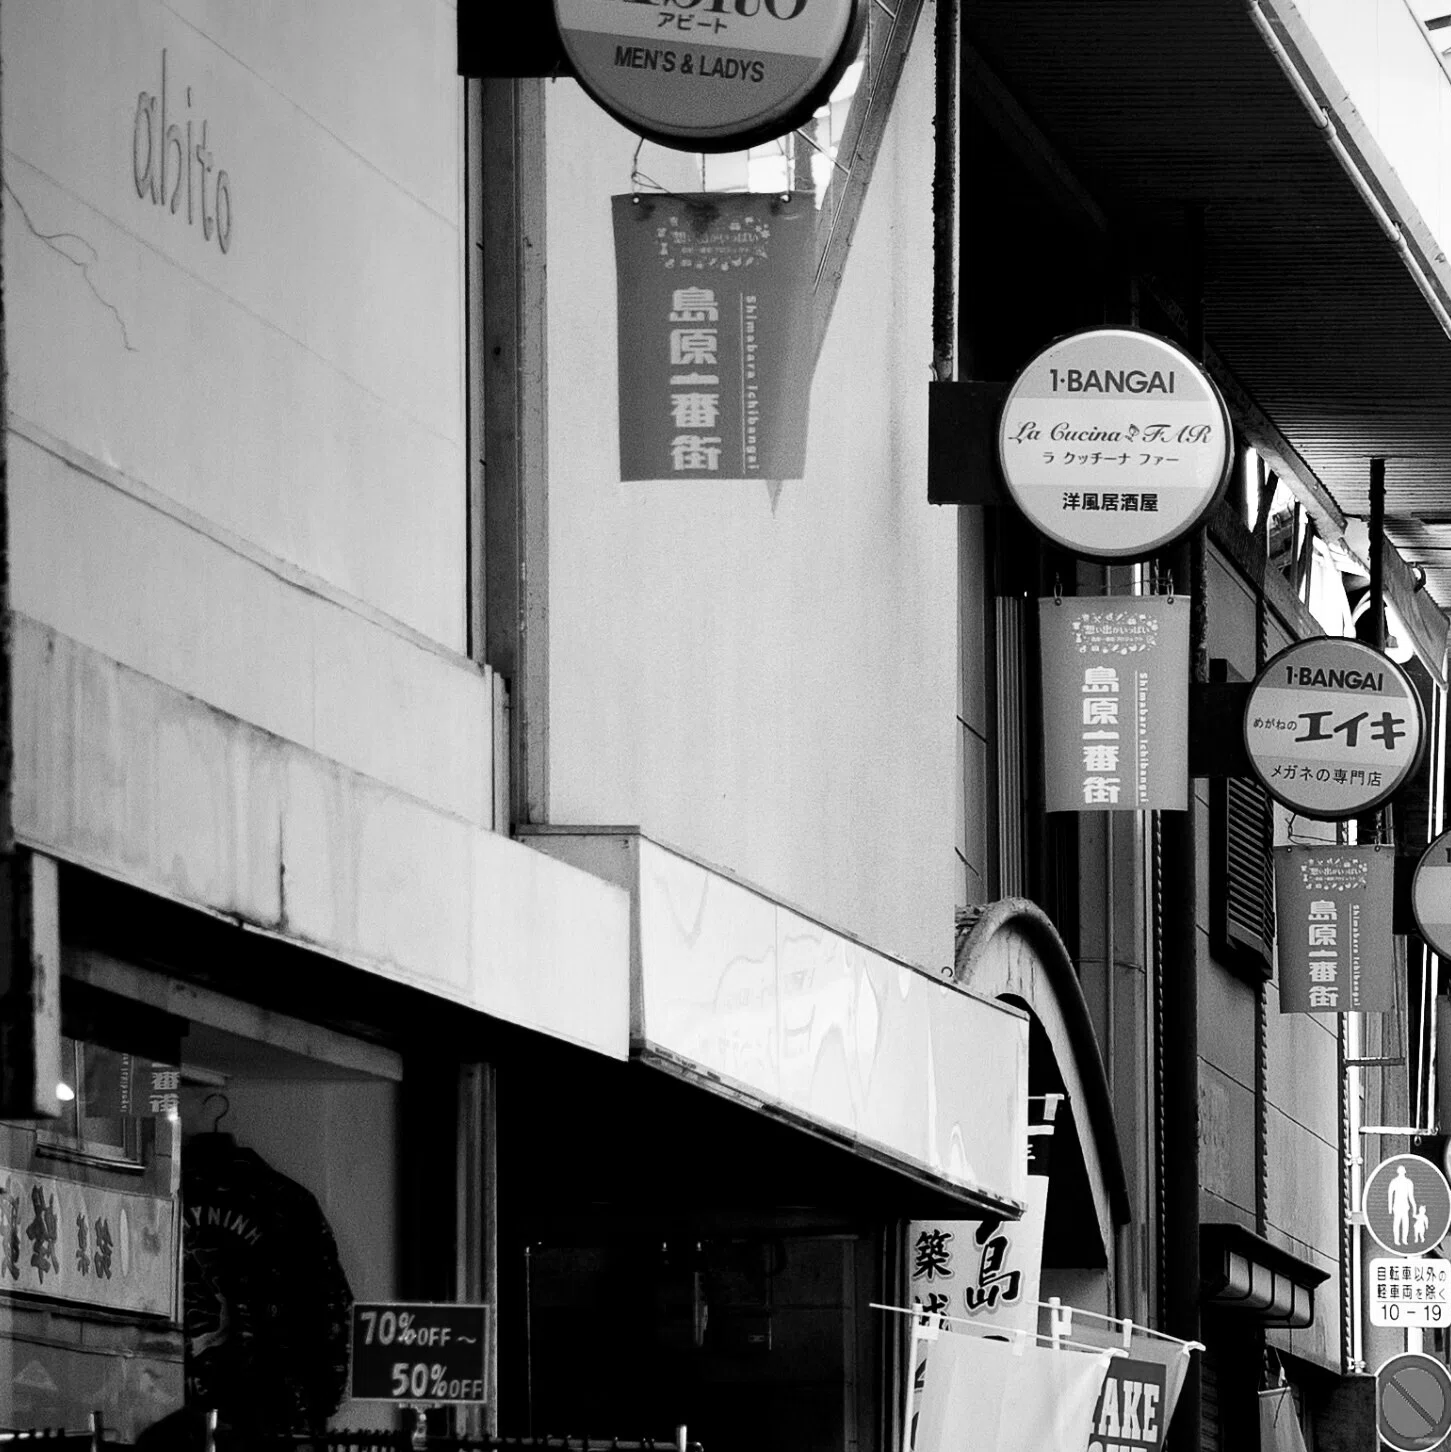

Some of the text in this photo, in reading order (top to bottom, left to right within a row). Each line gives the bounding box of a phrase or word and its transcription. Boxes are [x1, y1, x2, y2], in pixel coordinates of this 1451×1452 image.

[657, 12, 728, 34] アビート
[614, 46, 765, 82] MEN'S & LADYS
[669, 286, 722, 471] 島原一番街
[745, 295, 760, 471] Shimabara Ichibangai
[1008, 421, 1212, 444] La Cucina FAR
[1043, 452, 1180, 465] ラ クッチーナ ファー
[1063, 492, 1159, 512] 洋風居酒屋
[1082, 666, 1120, 804] 島原一番街
[1253, 711, 1406, 750] めがねの エイキ
[1271, 764, 1383, 787] メガネの専門店
[1308, 899, 1338, 1007] 島原一番街
[966, 1220, 1021, 1310] 島
[1377, 1266, 1446, 1282] 自転車以外の
[1377, 1284, 1446, 1300] 軽車両を除く
[1381, 1304, 1400, 1321] 10
[1424, 1304, 1442, 1321] 19
[1092, 1377, 1160, 1443] AKE
